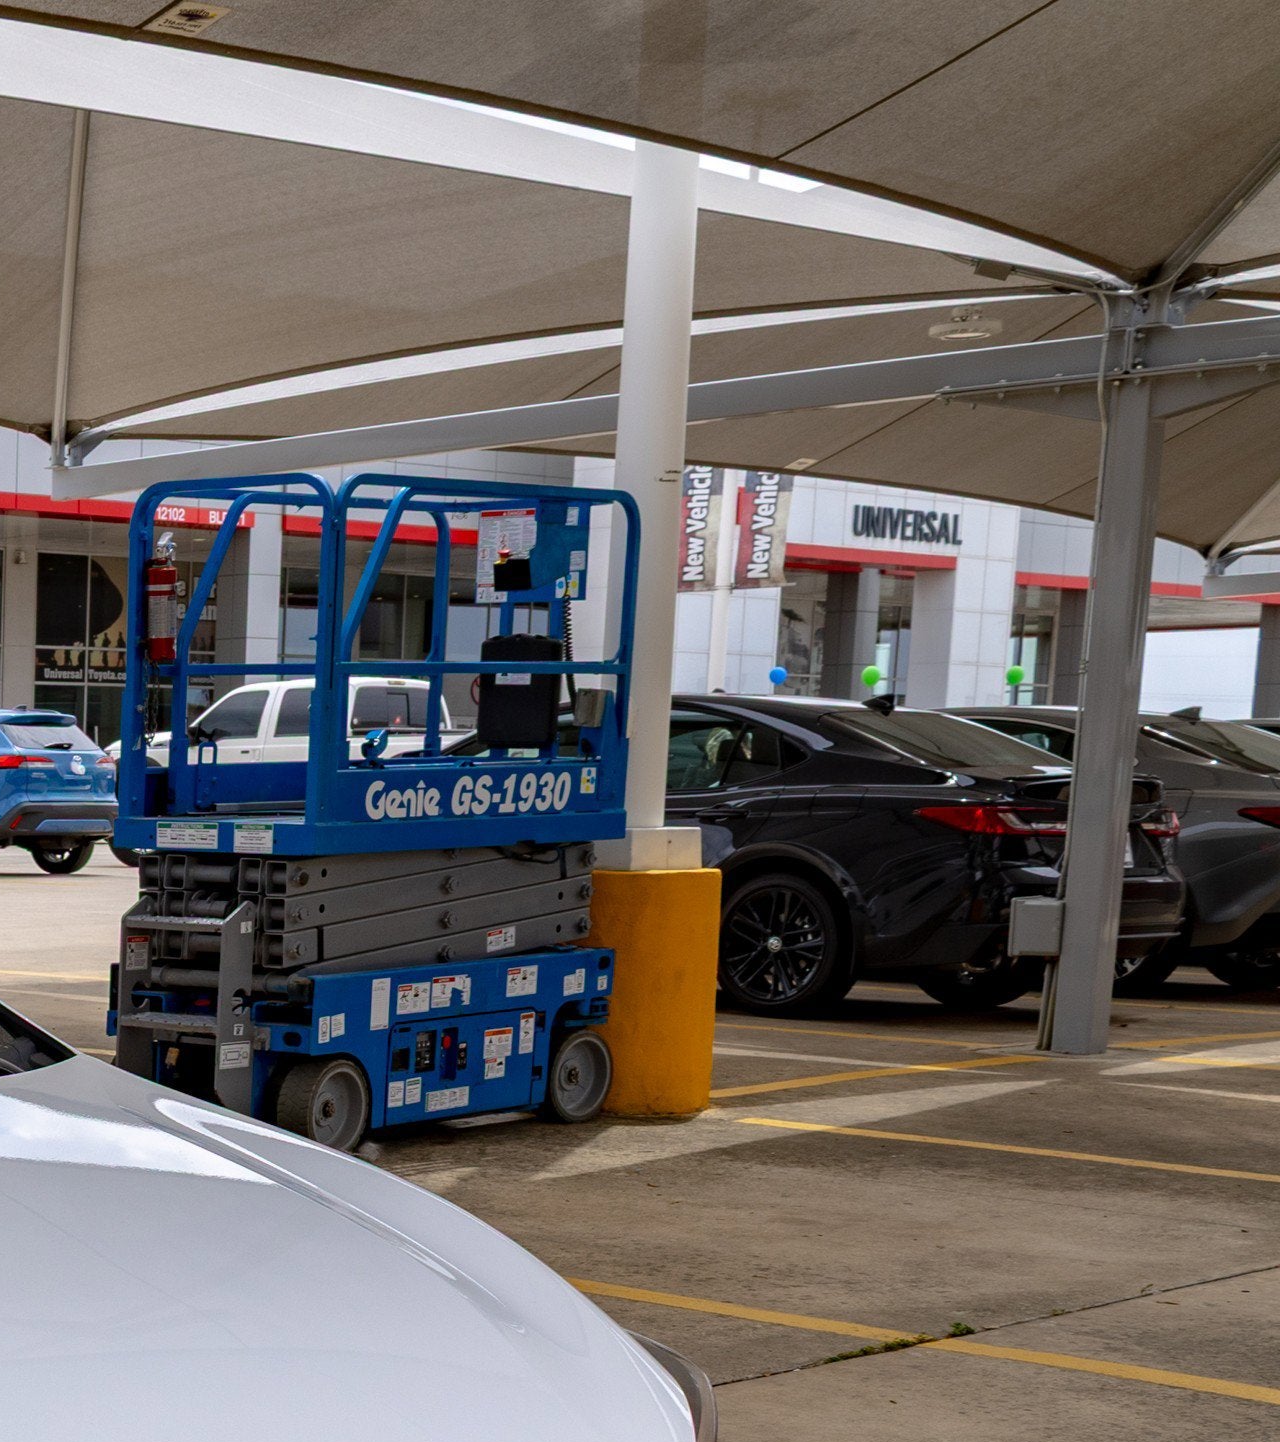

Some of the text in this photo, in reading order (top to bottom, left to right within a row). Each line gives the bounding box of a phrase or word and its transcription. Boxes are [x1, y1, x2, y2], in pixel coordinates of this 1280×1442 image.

[156, 507, 185, 521] 12102
[852, 504, 963, 546] UNIVERSAL
[682, 537, 705, 582] New
[747, 534, 772, 579] New
[43, 668, 127, 682] Universal Toyota.co
[365, 771, 572, 820] Genie GS-1930
